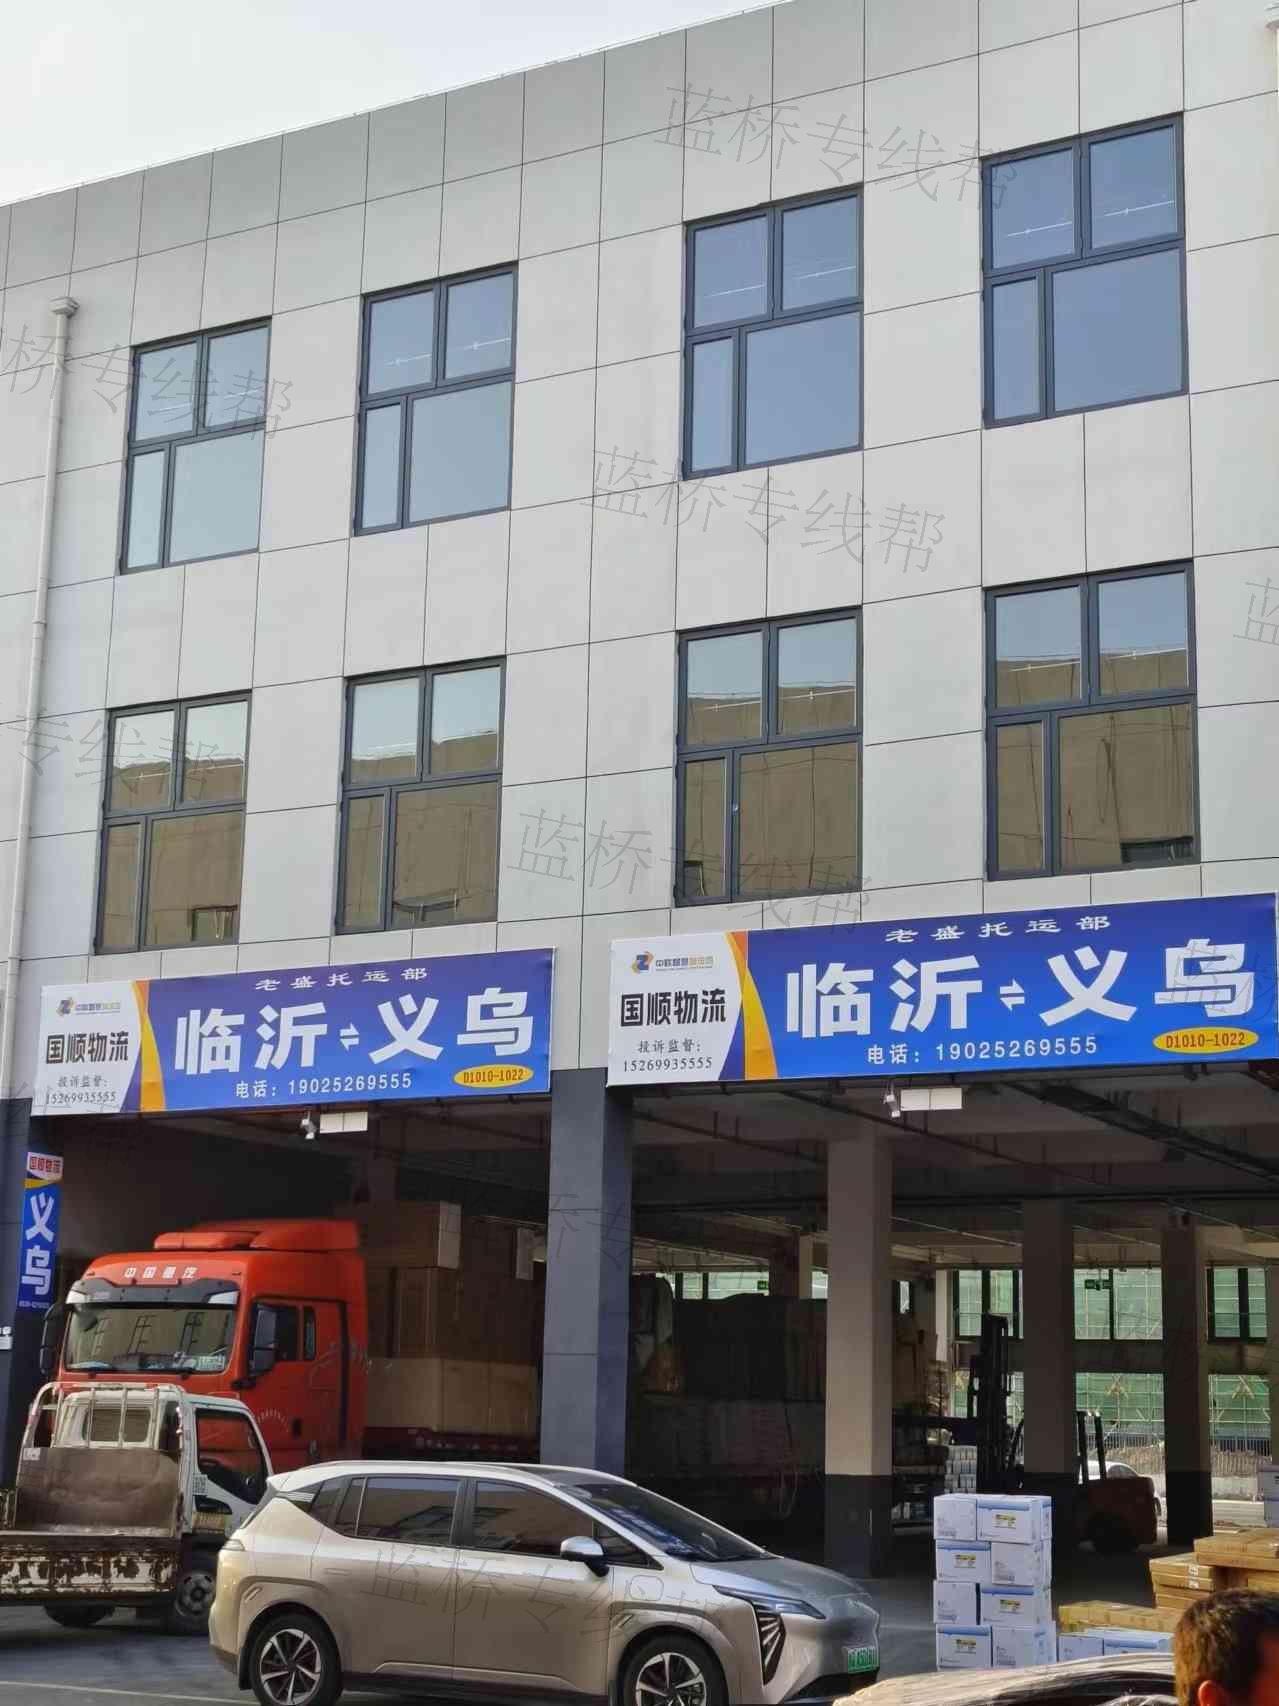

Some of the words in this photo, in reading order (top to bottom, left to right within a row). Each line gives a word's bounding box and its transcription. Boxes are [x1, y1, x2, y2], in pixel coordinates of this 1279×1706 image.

[885, 915, 1111, 943] 老盛托运部
[255, 967, 427, 991] 老盛托运部
[786, 955, 983, 1039] 临沂
[1039, 938, 1254, 1027] 义乌
[620, 988, 726, 1027] 国顺物流
[174, 1002, 328, 1075] 临沂
[368, 987, 534, 1065] 义乌
[1166, 1031, 1245, 1049] D1010-1022
[46, 1031, 129, 1064] 国顺物流
[463, 1068, 524, 1084] D1010-1022
[623, 1056, 712, 1072] 15269935555
[21, 1191, 55, 1296] 义乌
